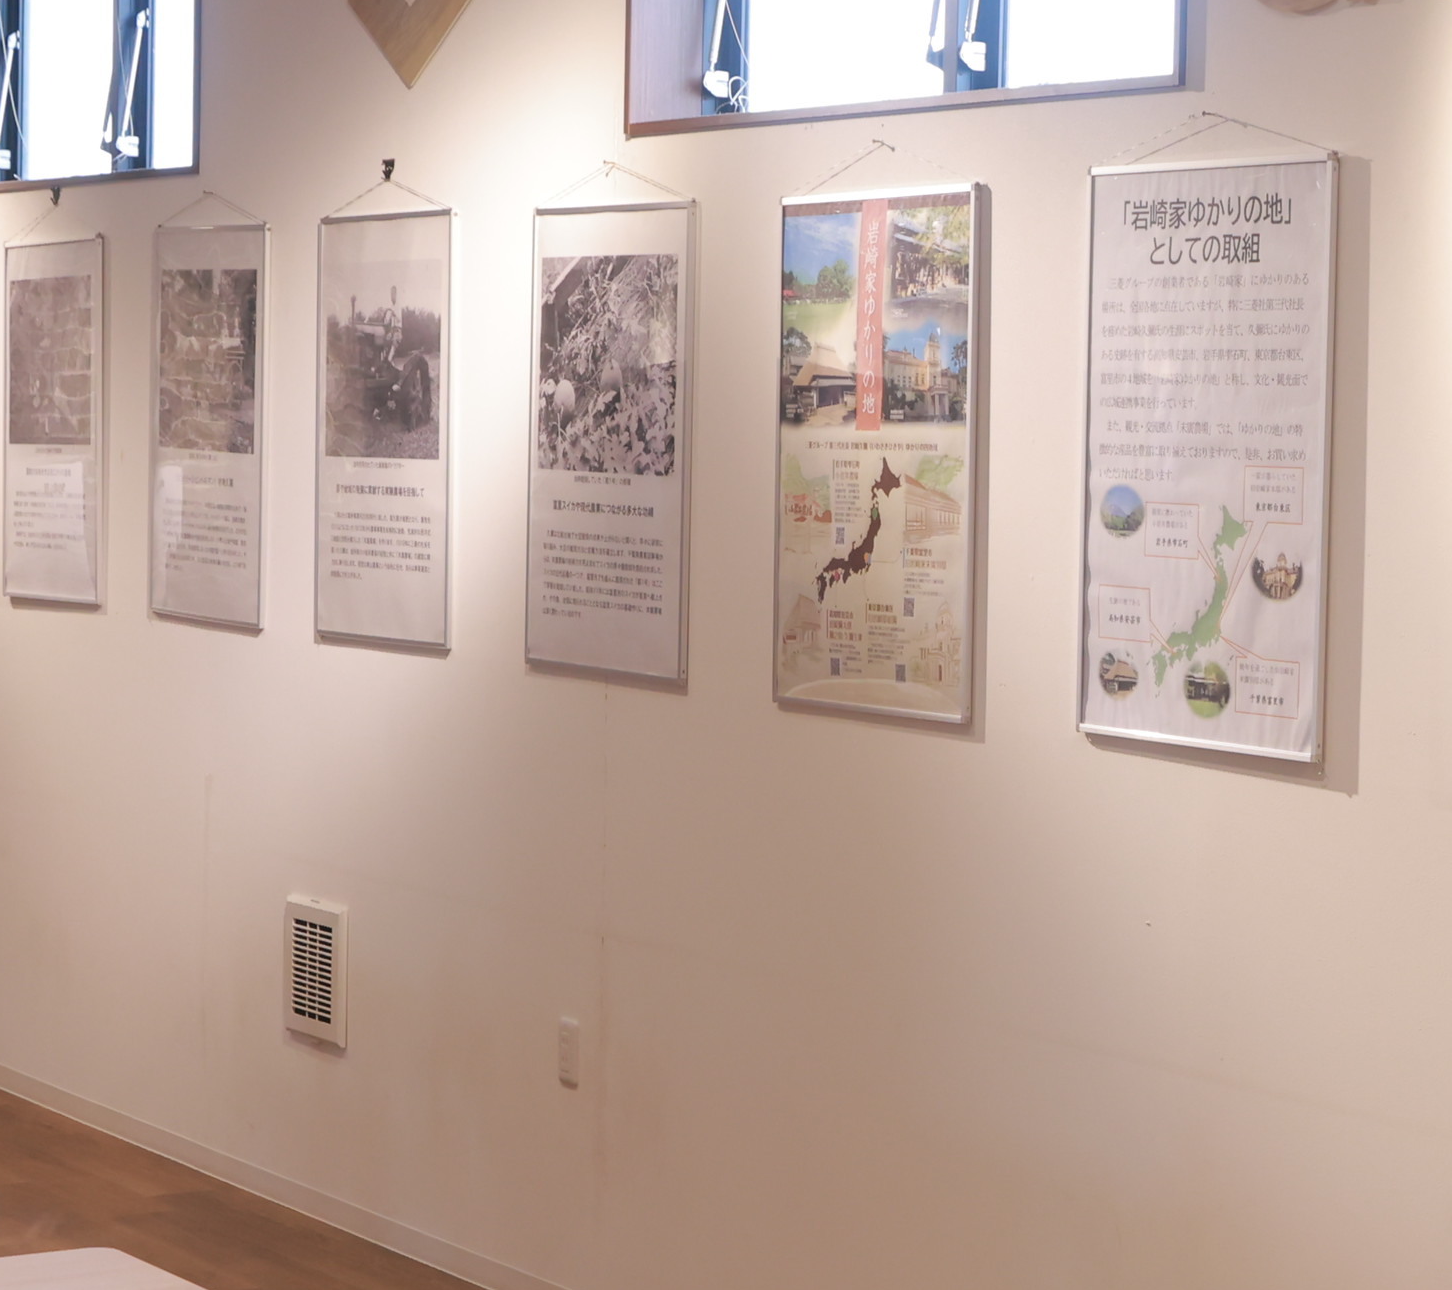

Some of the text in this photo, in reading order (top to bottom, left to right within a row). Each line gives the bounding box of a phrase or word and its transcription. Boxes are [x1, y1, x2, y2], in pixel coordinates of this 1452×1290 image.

[1149, 232, 1261, 266] としての取組
